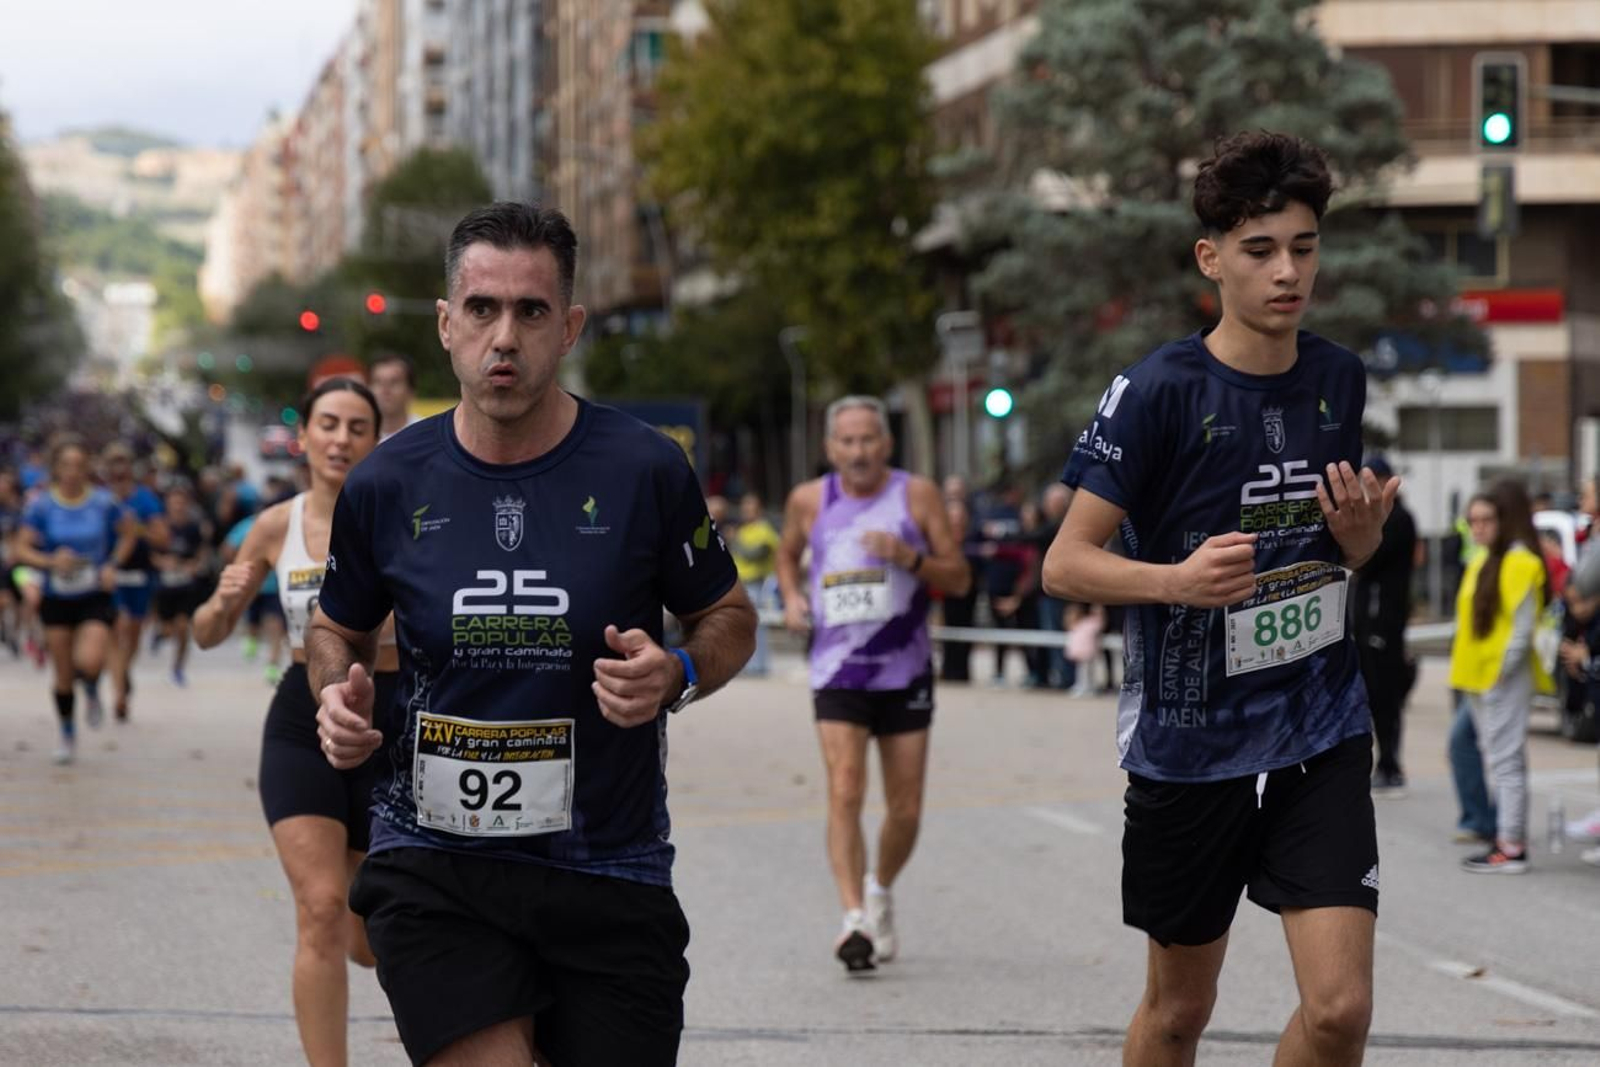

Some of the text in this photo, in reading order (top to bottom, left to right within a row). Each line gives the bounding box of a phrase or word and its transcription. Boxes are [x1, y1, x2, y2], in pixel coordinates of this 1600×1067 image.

[1240, 460, 1324, 505] 25
[1240, 511, 1323, 532] POPULAR
[452, 569, 570, 616] 25
[452, 616, 570, 631] CARRERA
[1254, 595, 1322, 647] 886
[453, 631, 572, 646] POPULAR
[453, 646, 572, 658] y gran caminata
[1163, 645, 1182, 701] SANTA
[1183, 676, 1200, 702] DE
[422, 720, 567, 744] XXV CARRERA POPULAR
[467, 737, 499, 748] gran
[506, 736, 567, 748] caminata
[459, 768, 522, 812] 92
